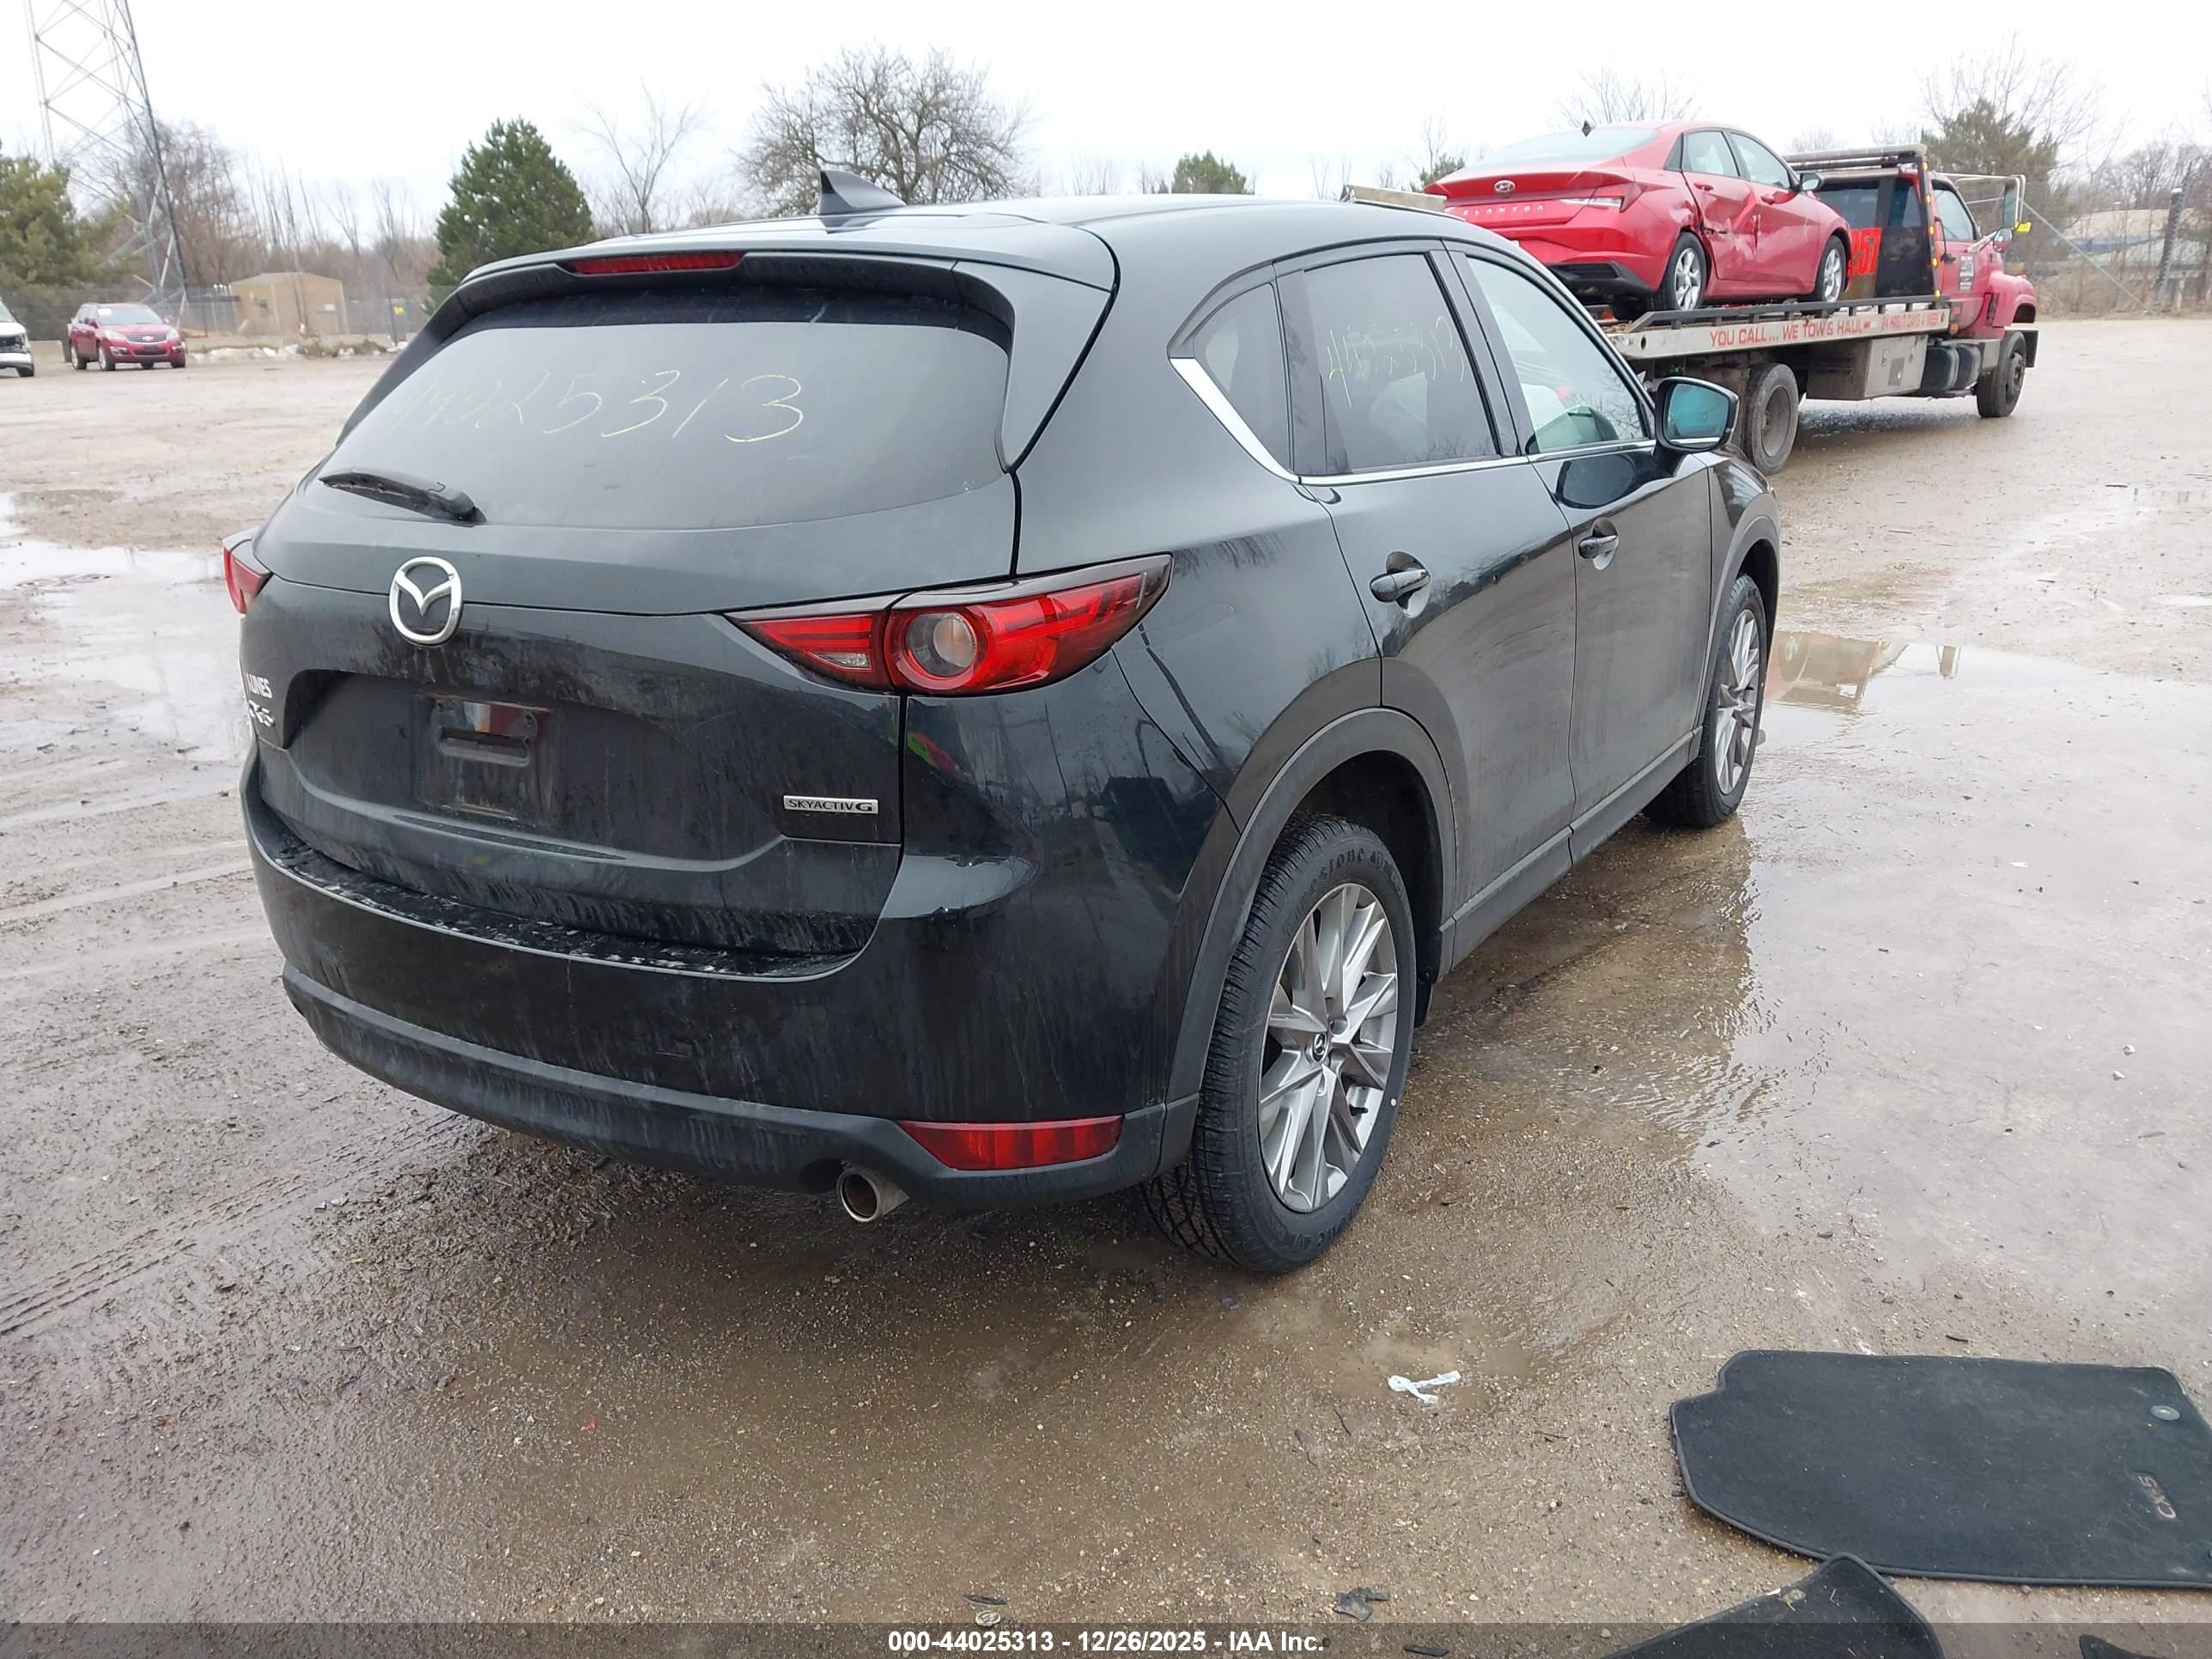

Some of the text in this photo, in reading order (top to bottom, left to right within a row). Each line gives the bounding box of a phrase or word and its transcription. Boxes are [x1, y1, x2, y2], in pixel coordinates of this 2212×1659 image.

[1711, 329, 1735, 347] YOU
[1783, 324, 1799, 339] WE
[1803, 321, 1826, 337] TOW
[1838, 319, 1863, 334] HAUL
